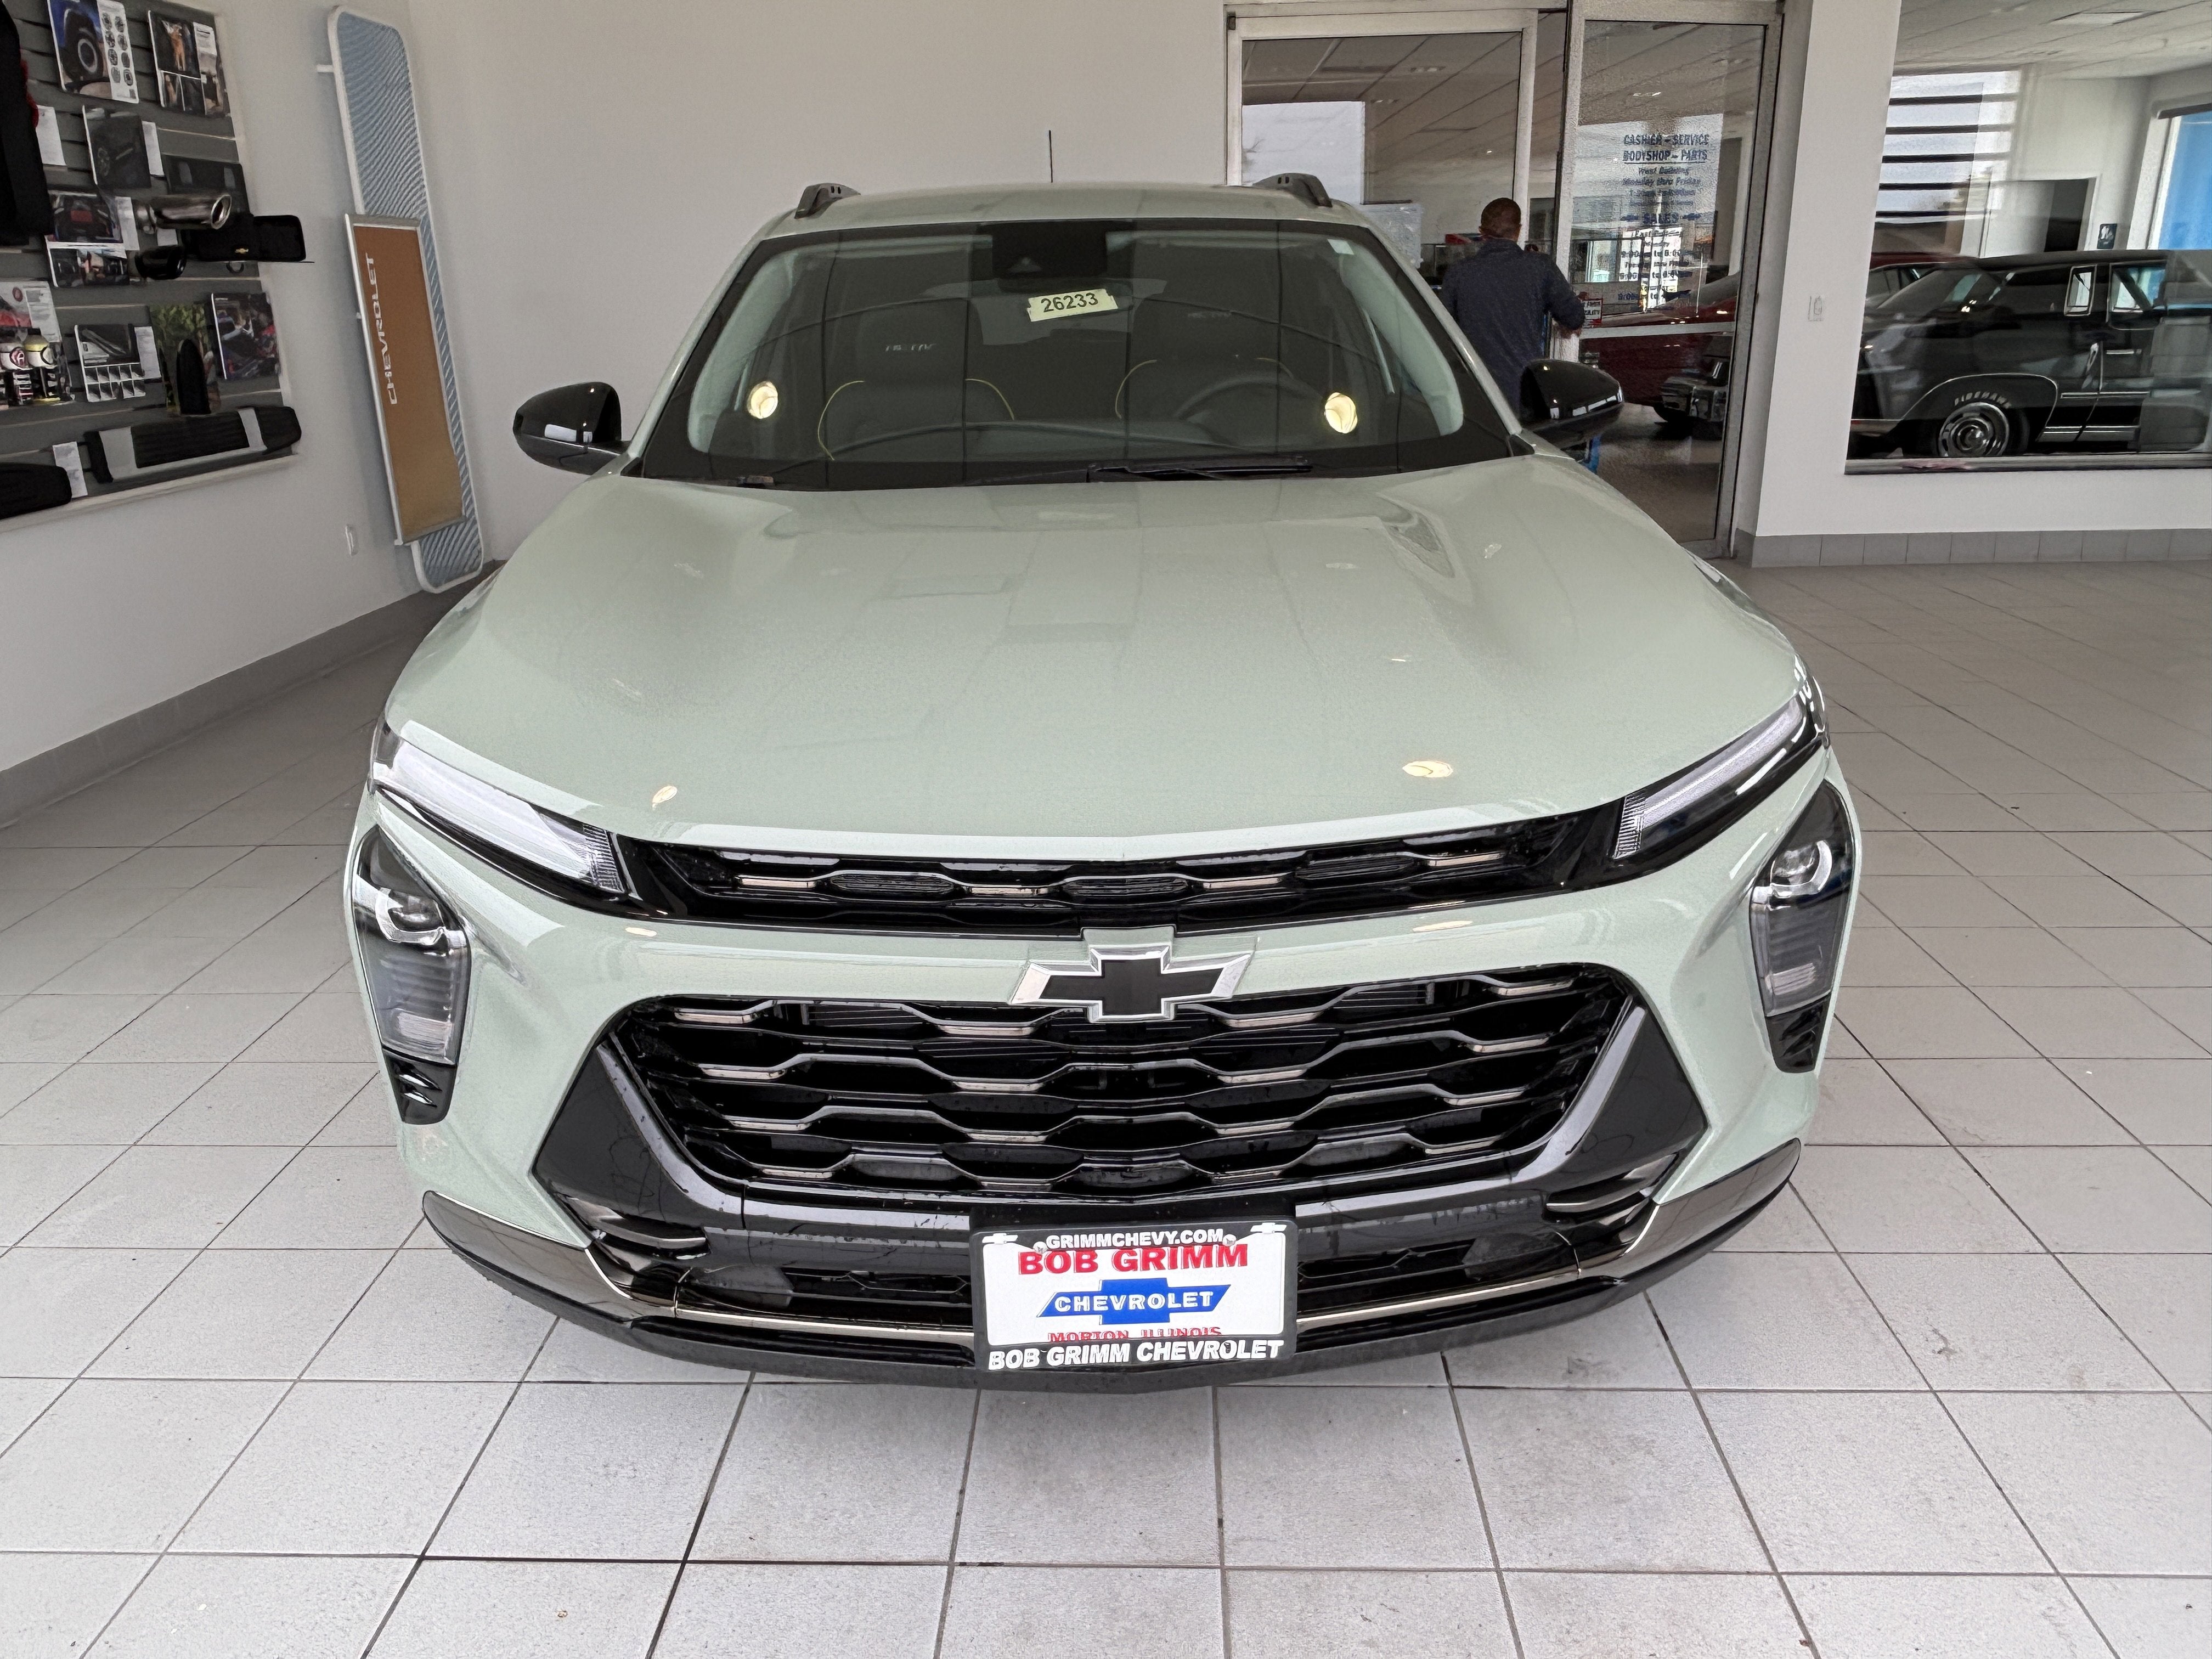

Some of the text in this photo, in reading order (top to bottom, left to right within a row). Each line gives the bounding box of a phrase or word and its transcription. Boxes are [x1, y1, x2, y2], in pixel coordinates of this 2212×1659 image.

[1624, 134, 1662, 145] CASHIER
[1673, 133, 1709, 145] SERVICE
[1623, 150, 1671, 161] BODYSHOP
[1681, 149, 1708, 161] PARTS
[1041, 292, 1098, 313] 26233
[1046, 1229, 1223, 1249] GRIMMCHEVY.COM
[1018, 1244, 1248, 1275] BOB GRIMM
[1054, 1290, 1214, 1312] CHEVROLET
[989, 1340, 1284, 1370] BOB GRIMM CHEVROLET
